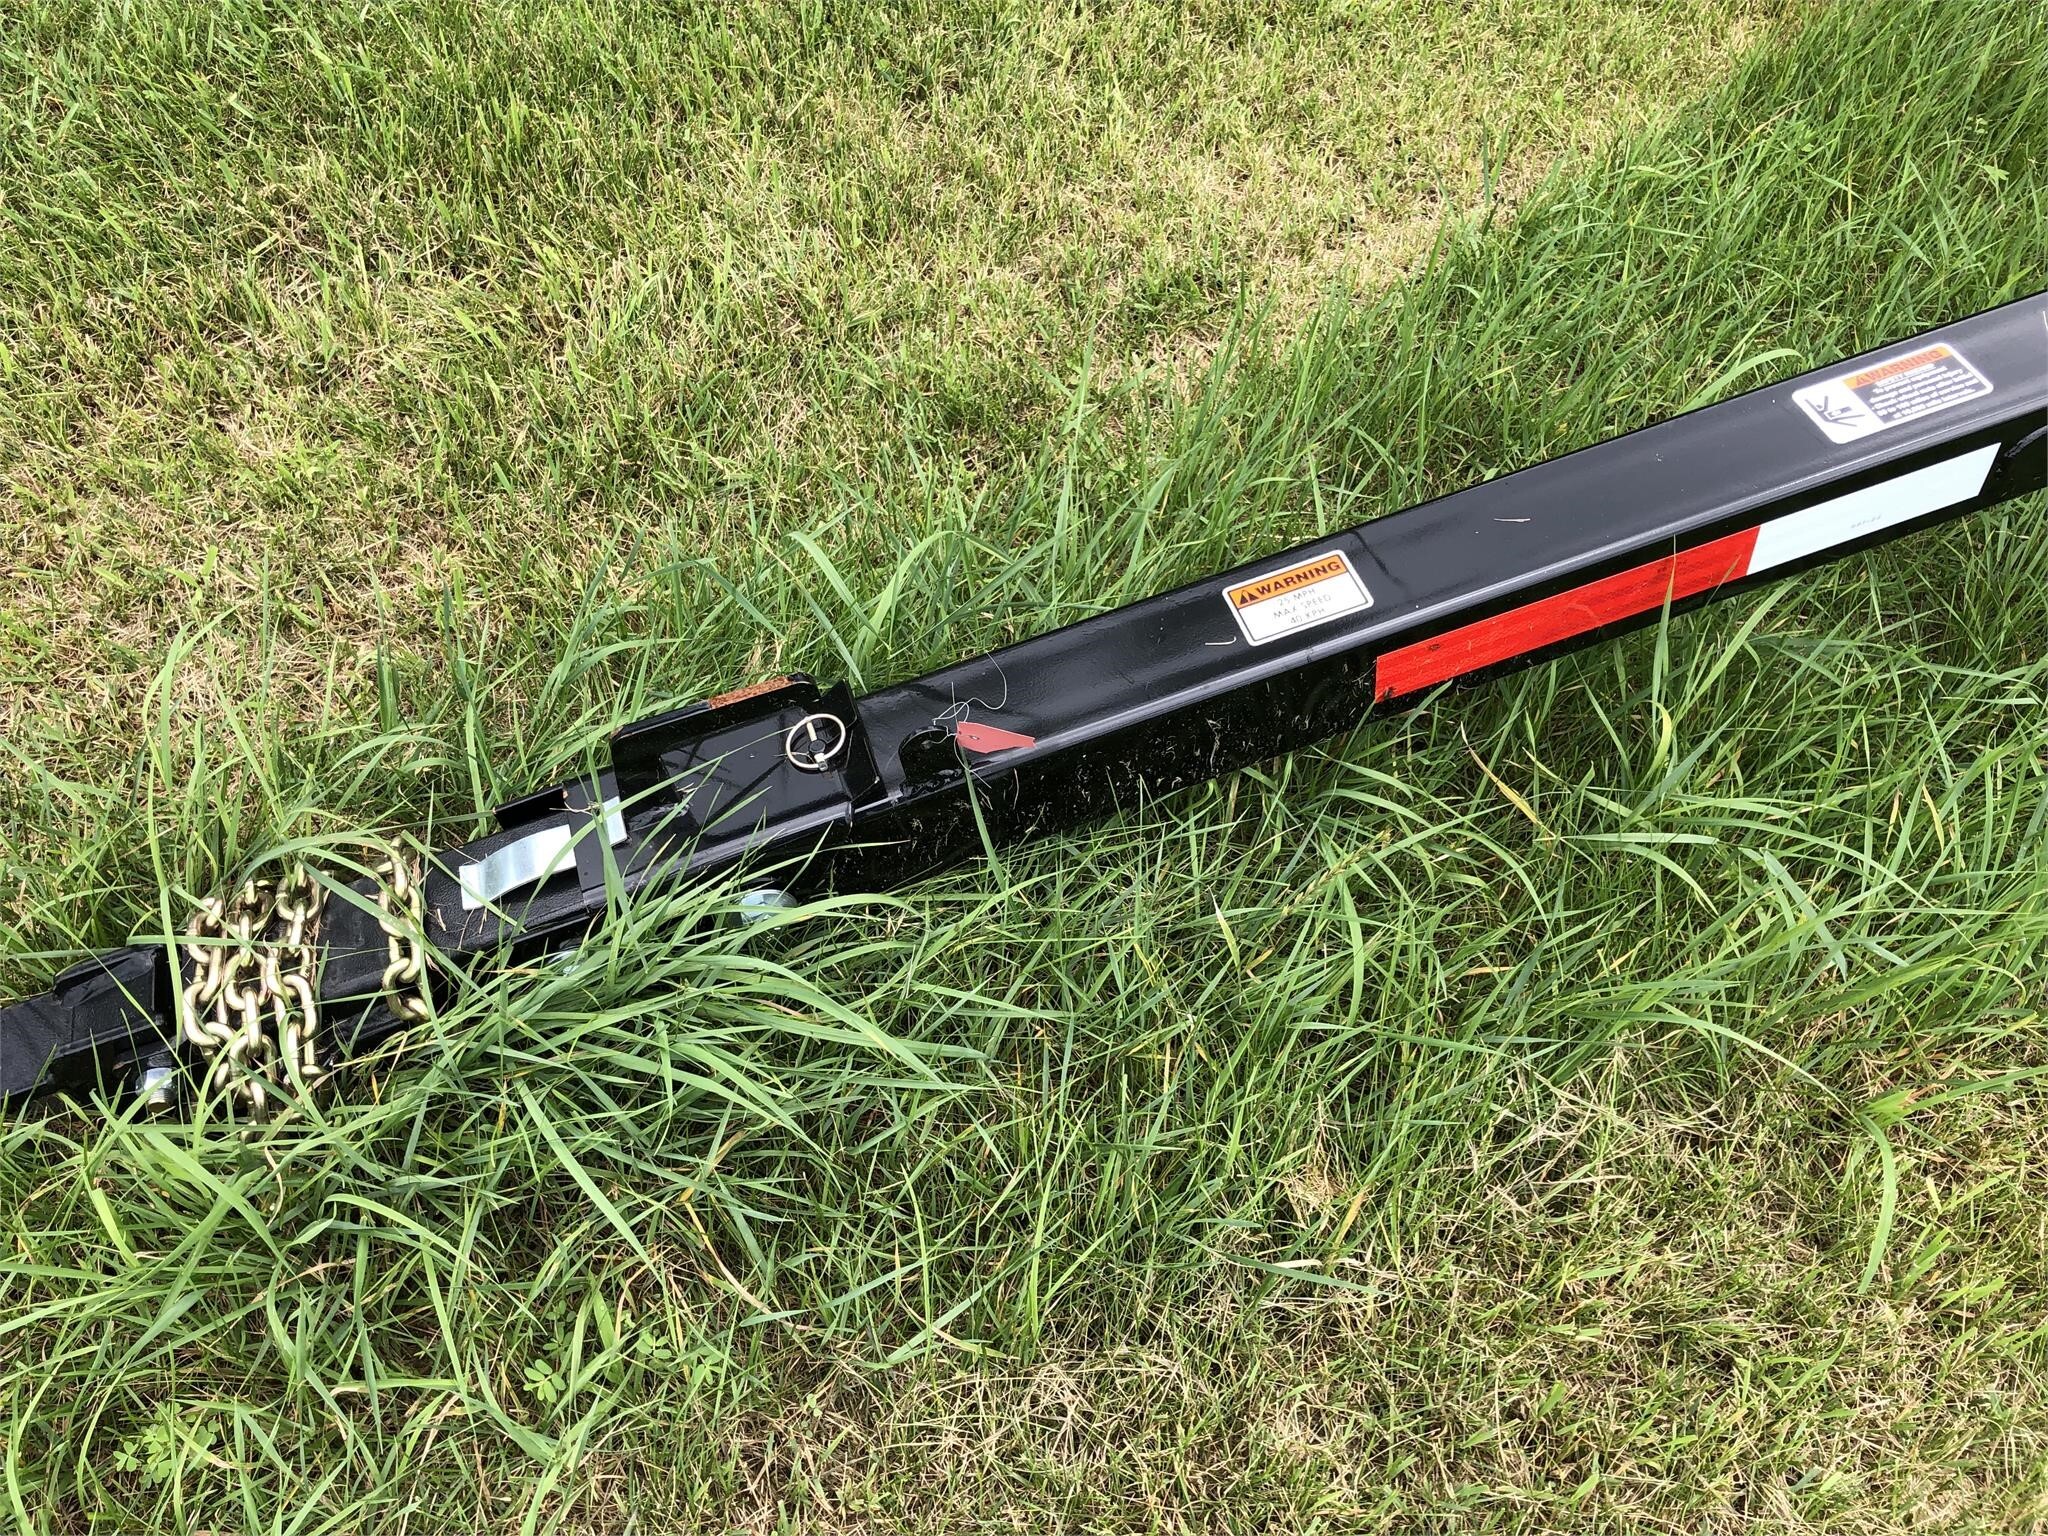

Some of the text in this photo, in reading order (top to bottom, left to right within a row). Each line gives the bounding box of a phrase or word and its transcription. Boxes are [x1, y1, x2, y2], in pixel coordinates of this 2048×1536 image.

[1866, 350, 1943, 380] WARNING
[1256, 561, 1341, 596] WARNING
[1293, 589, 1315, 600] MPH
[1274, 595, 1331, 618] MAX SPEED
[1306, 608, 1327, 619] KPH
